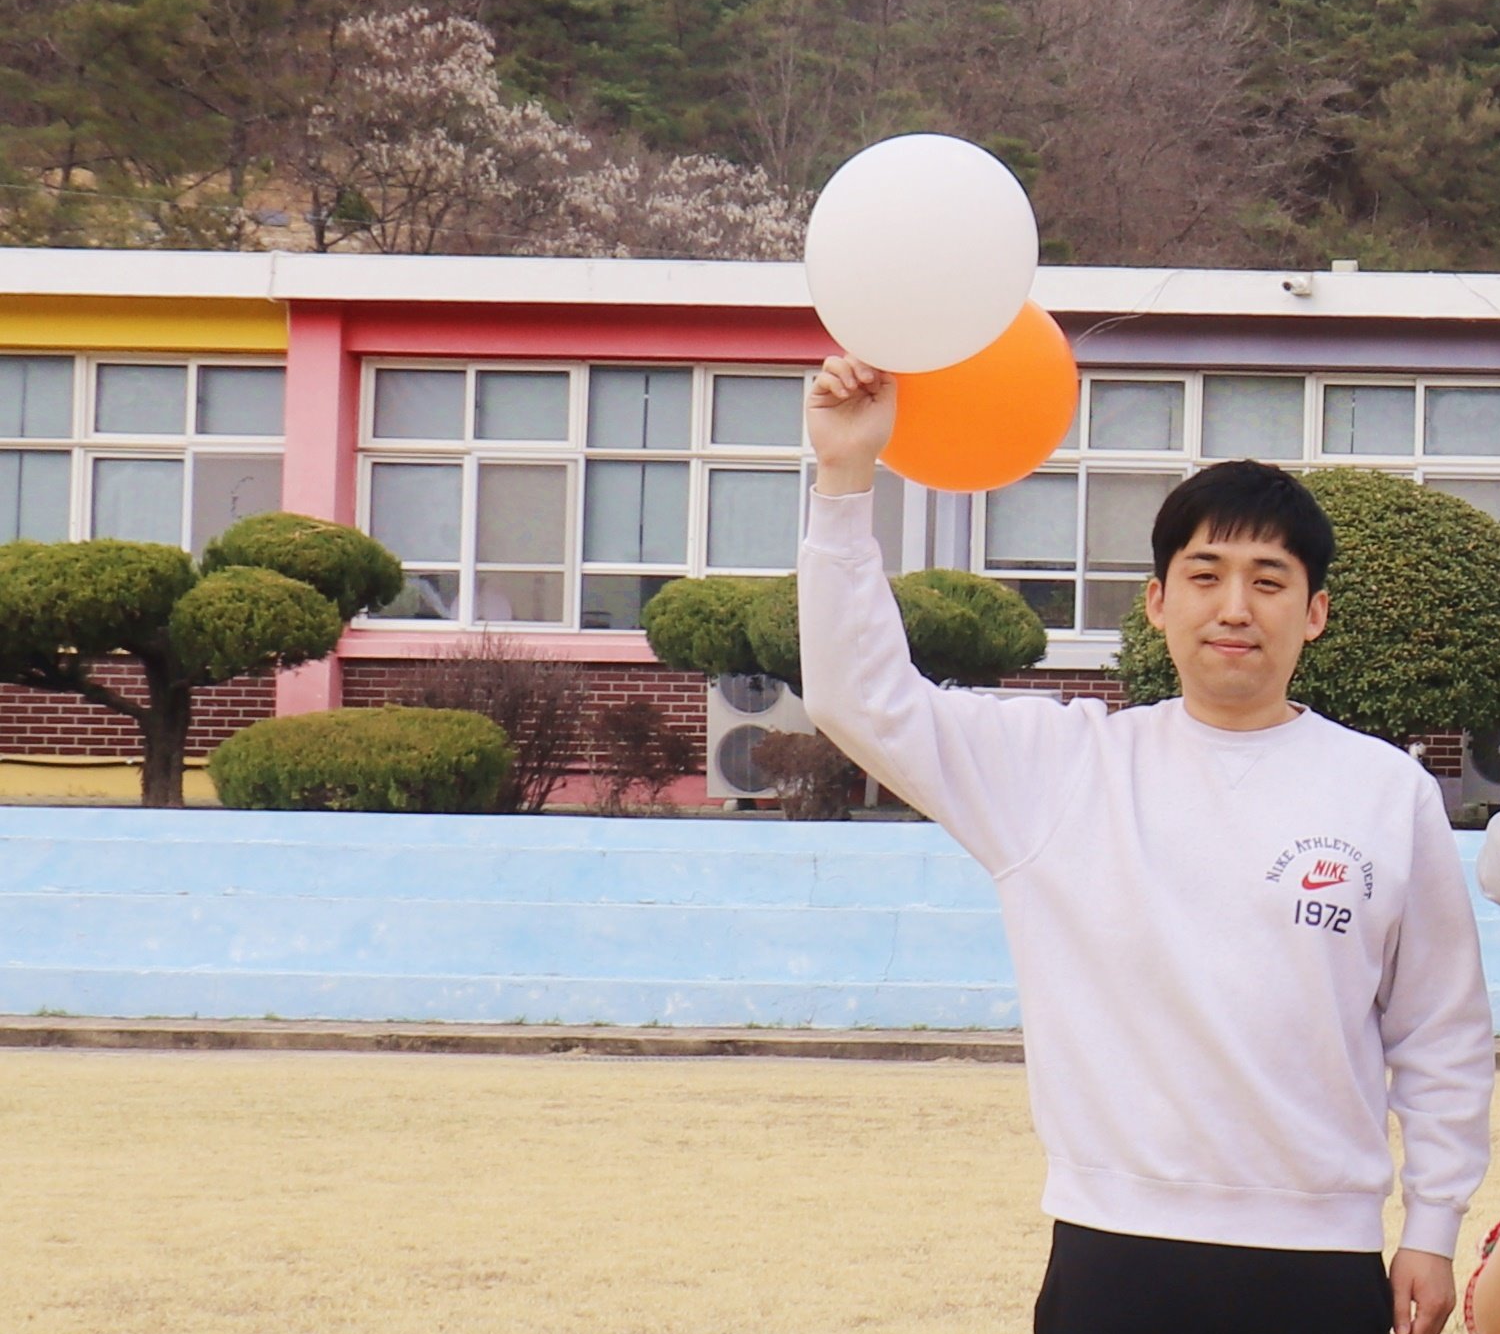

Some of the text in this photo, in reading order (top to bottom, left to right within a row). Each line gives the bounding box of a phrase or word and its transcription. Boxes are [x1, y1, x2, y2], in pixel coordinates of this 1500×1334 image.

[1265, 849, 1295, 883] NIKE
[1294, 836, 1363, 862] ATHLETIC
[1312, 859, 1350, 883] NIKE
[1294, 898, 1353, 935] 1972
